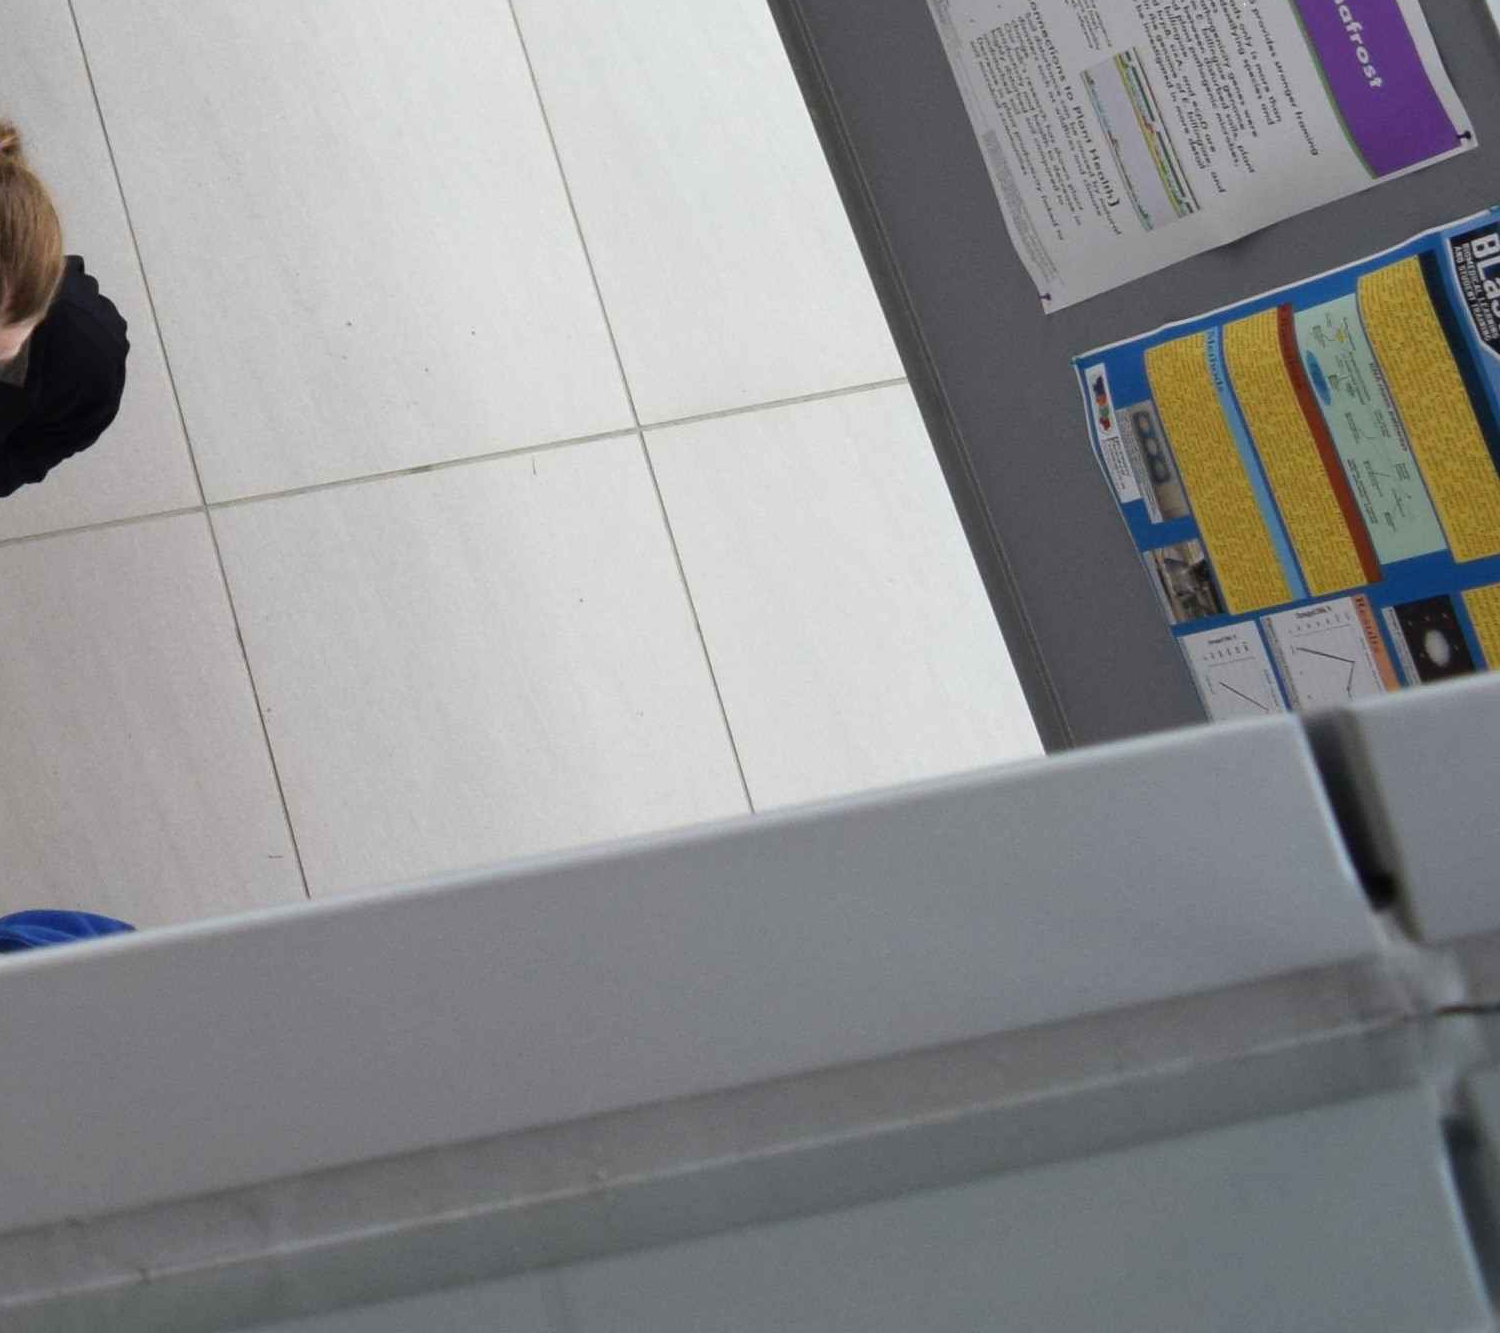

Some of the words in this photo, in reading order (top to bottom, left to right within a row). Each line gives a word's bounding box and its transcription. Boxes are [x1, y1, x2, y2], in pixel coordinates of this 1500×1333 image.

[1064, 85, 1073, 100] to
[1072, 106, 1091, 143] Plant
[1089, 148, 1113, 198] Health
[1452, 245, 1463, 262] AND
[1458, 263, 1477, 301] STUDENT
[1471, 301, 1491, 342] TRAINING
[1460, 242, 1484, 294] BIOMEDICAL
[1478, 295, 1499, 339] LEARNING
[1470, 233, 1500, 333] BLa
[1207, 330, 1225, 392] Methods
[1355, 596, 1377, 652] Results
